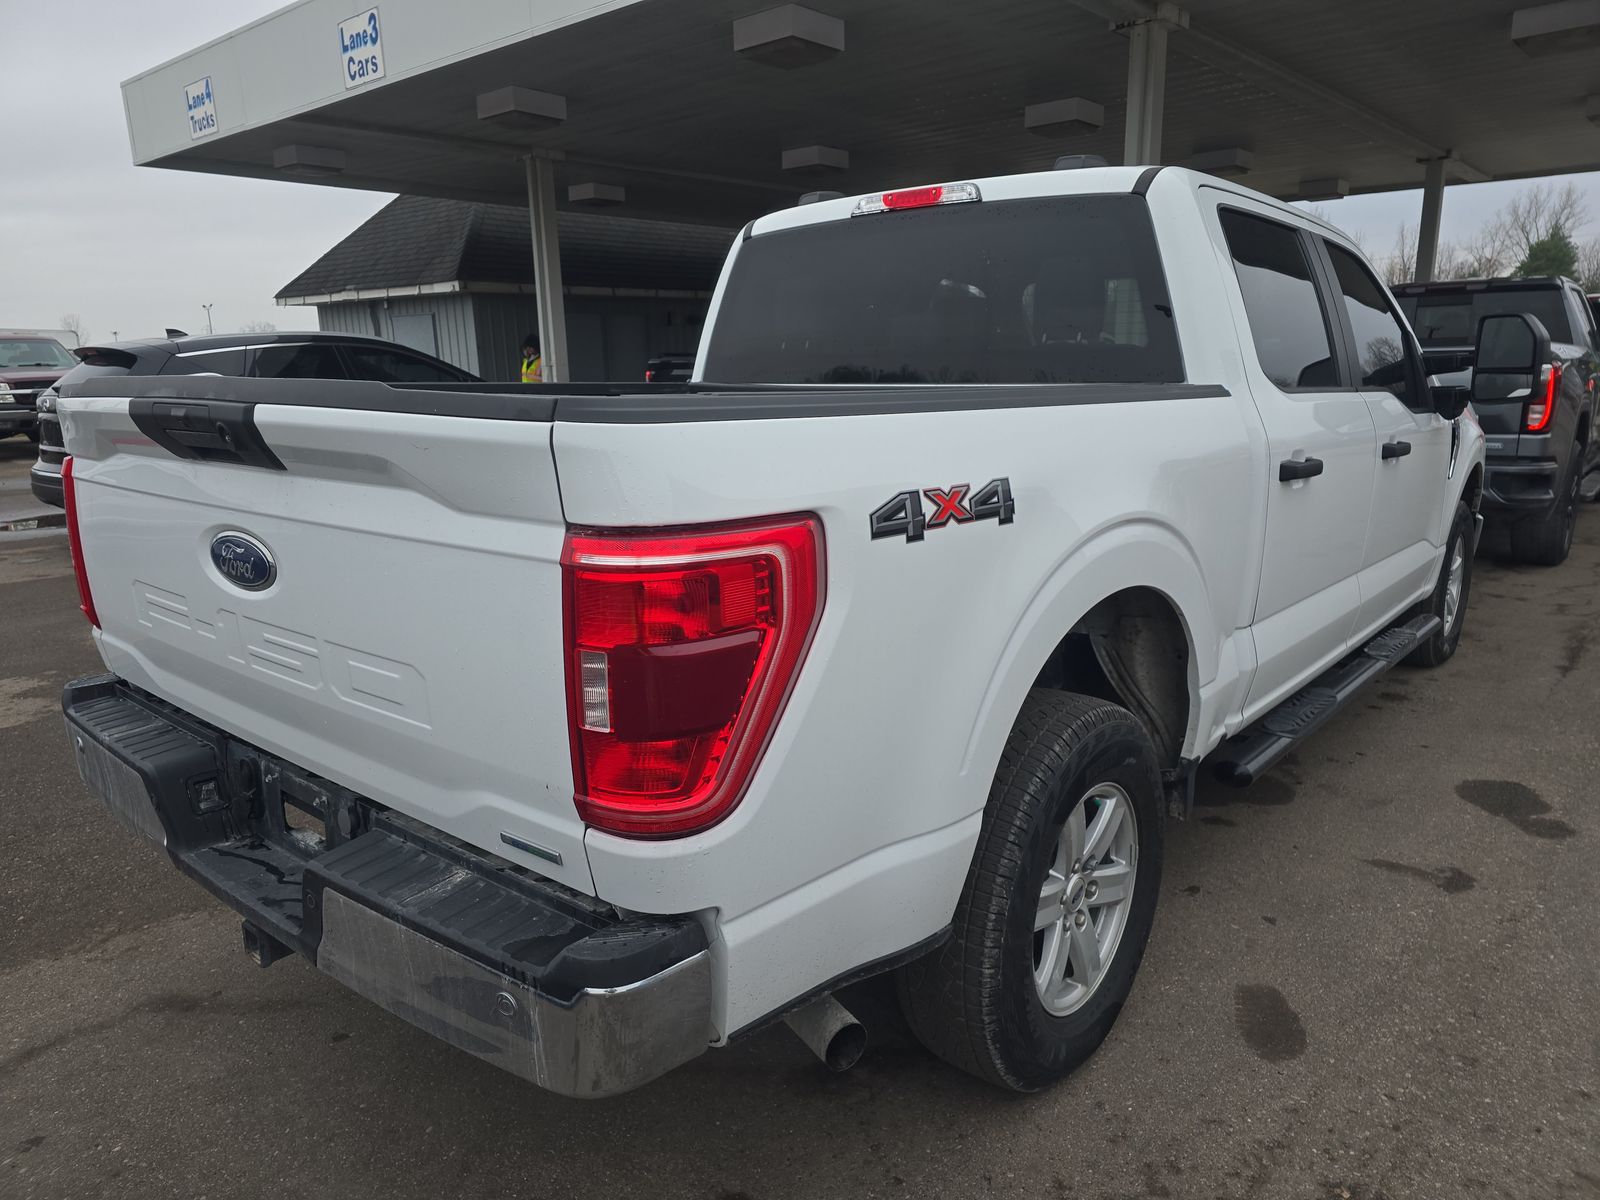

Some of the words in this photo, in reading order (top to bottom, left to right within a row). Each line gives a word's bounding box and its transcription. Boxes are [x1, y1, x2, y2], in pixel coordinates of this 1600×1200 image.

[347, 55, 378, 81] Cars
[190, 111, 215, 134] Trucks
[220, 542, 255, 580] Ford
